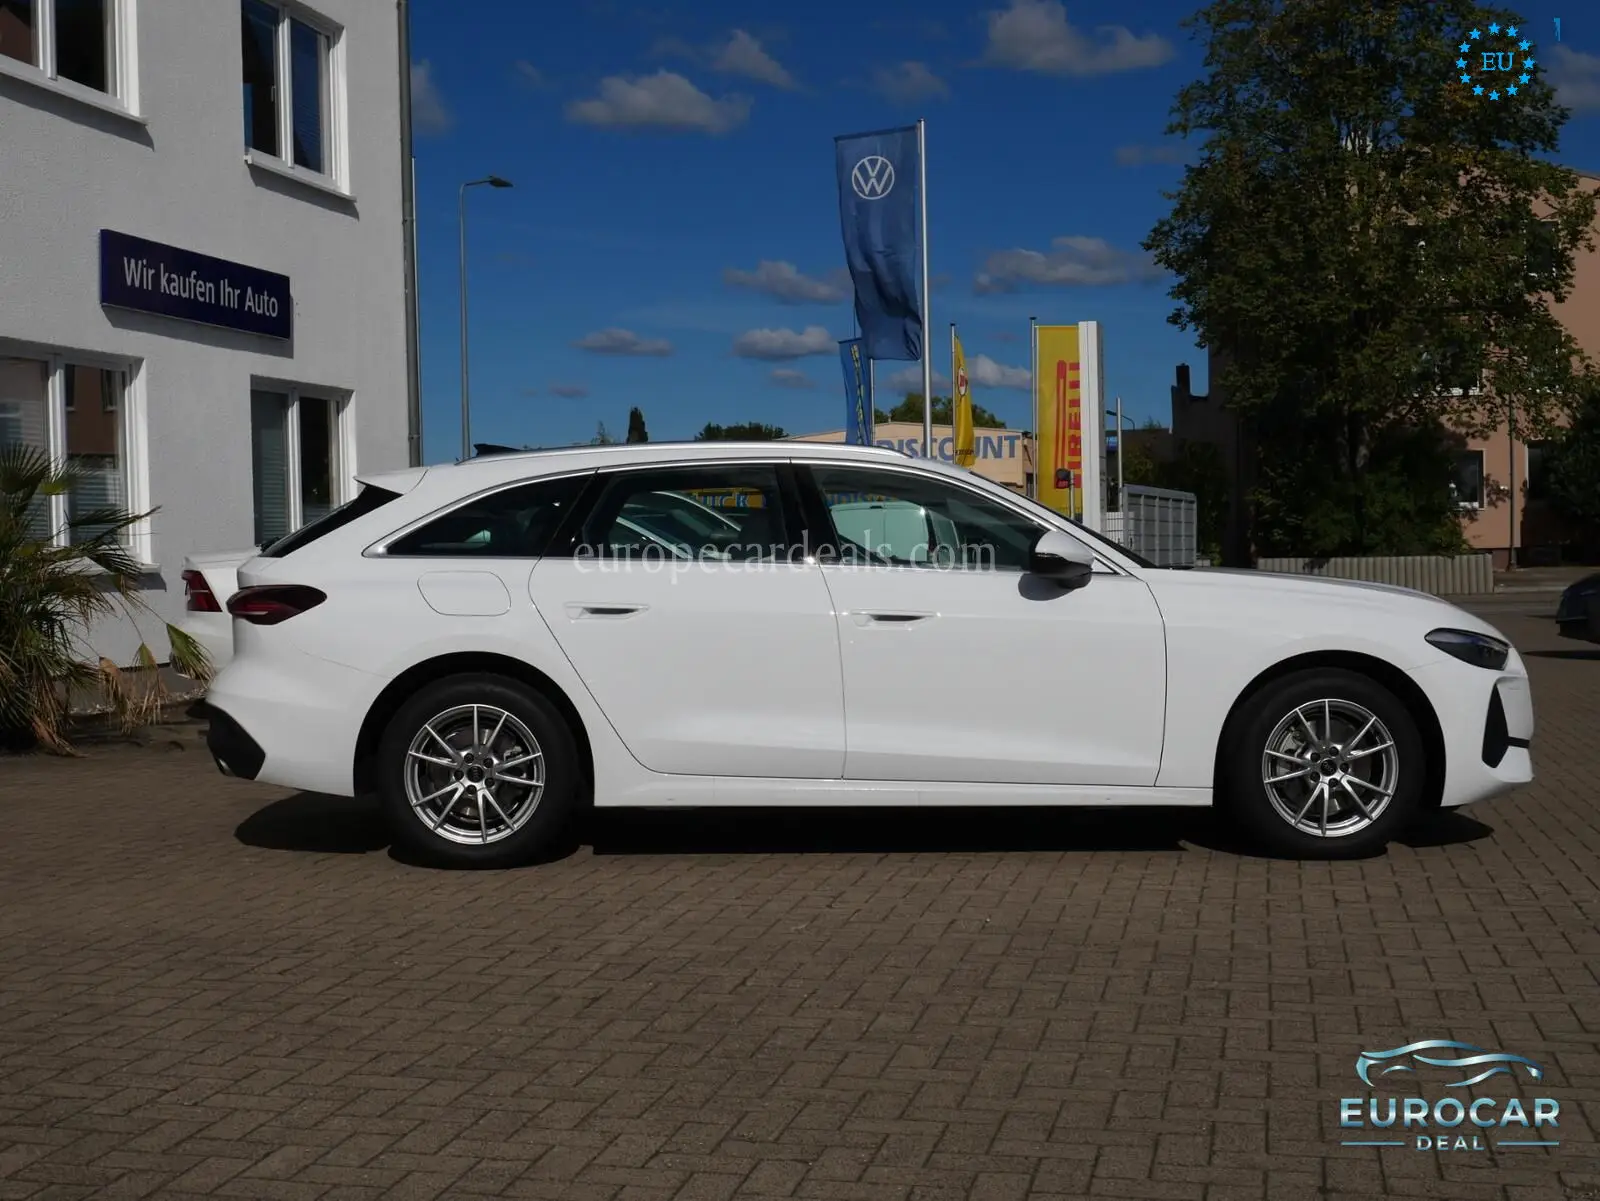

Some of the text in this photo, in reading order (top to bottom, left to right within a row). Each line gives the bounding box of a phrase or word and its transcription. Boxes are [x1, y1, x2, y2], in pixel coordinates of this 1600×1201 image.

[852, 156, 895, 200] VW
[123, 256, 279, 318] Wir kaufen Ihr Auto
